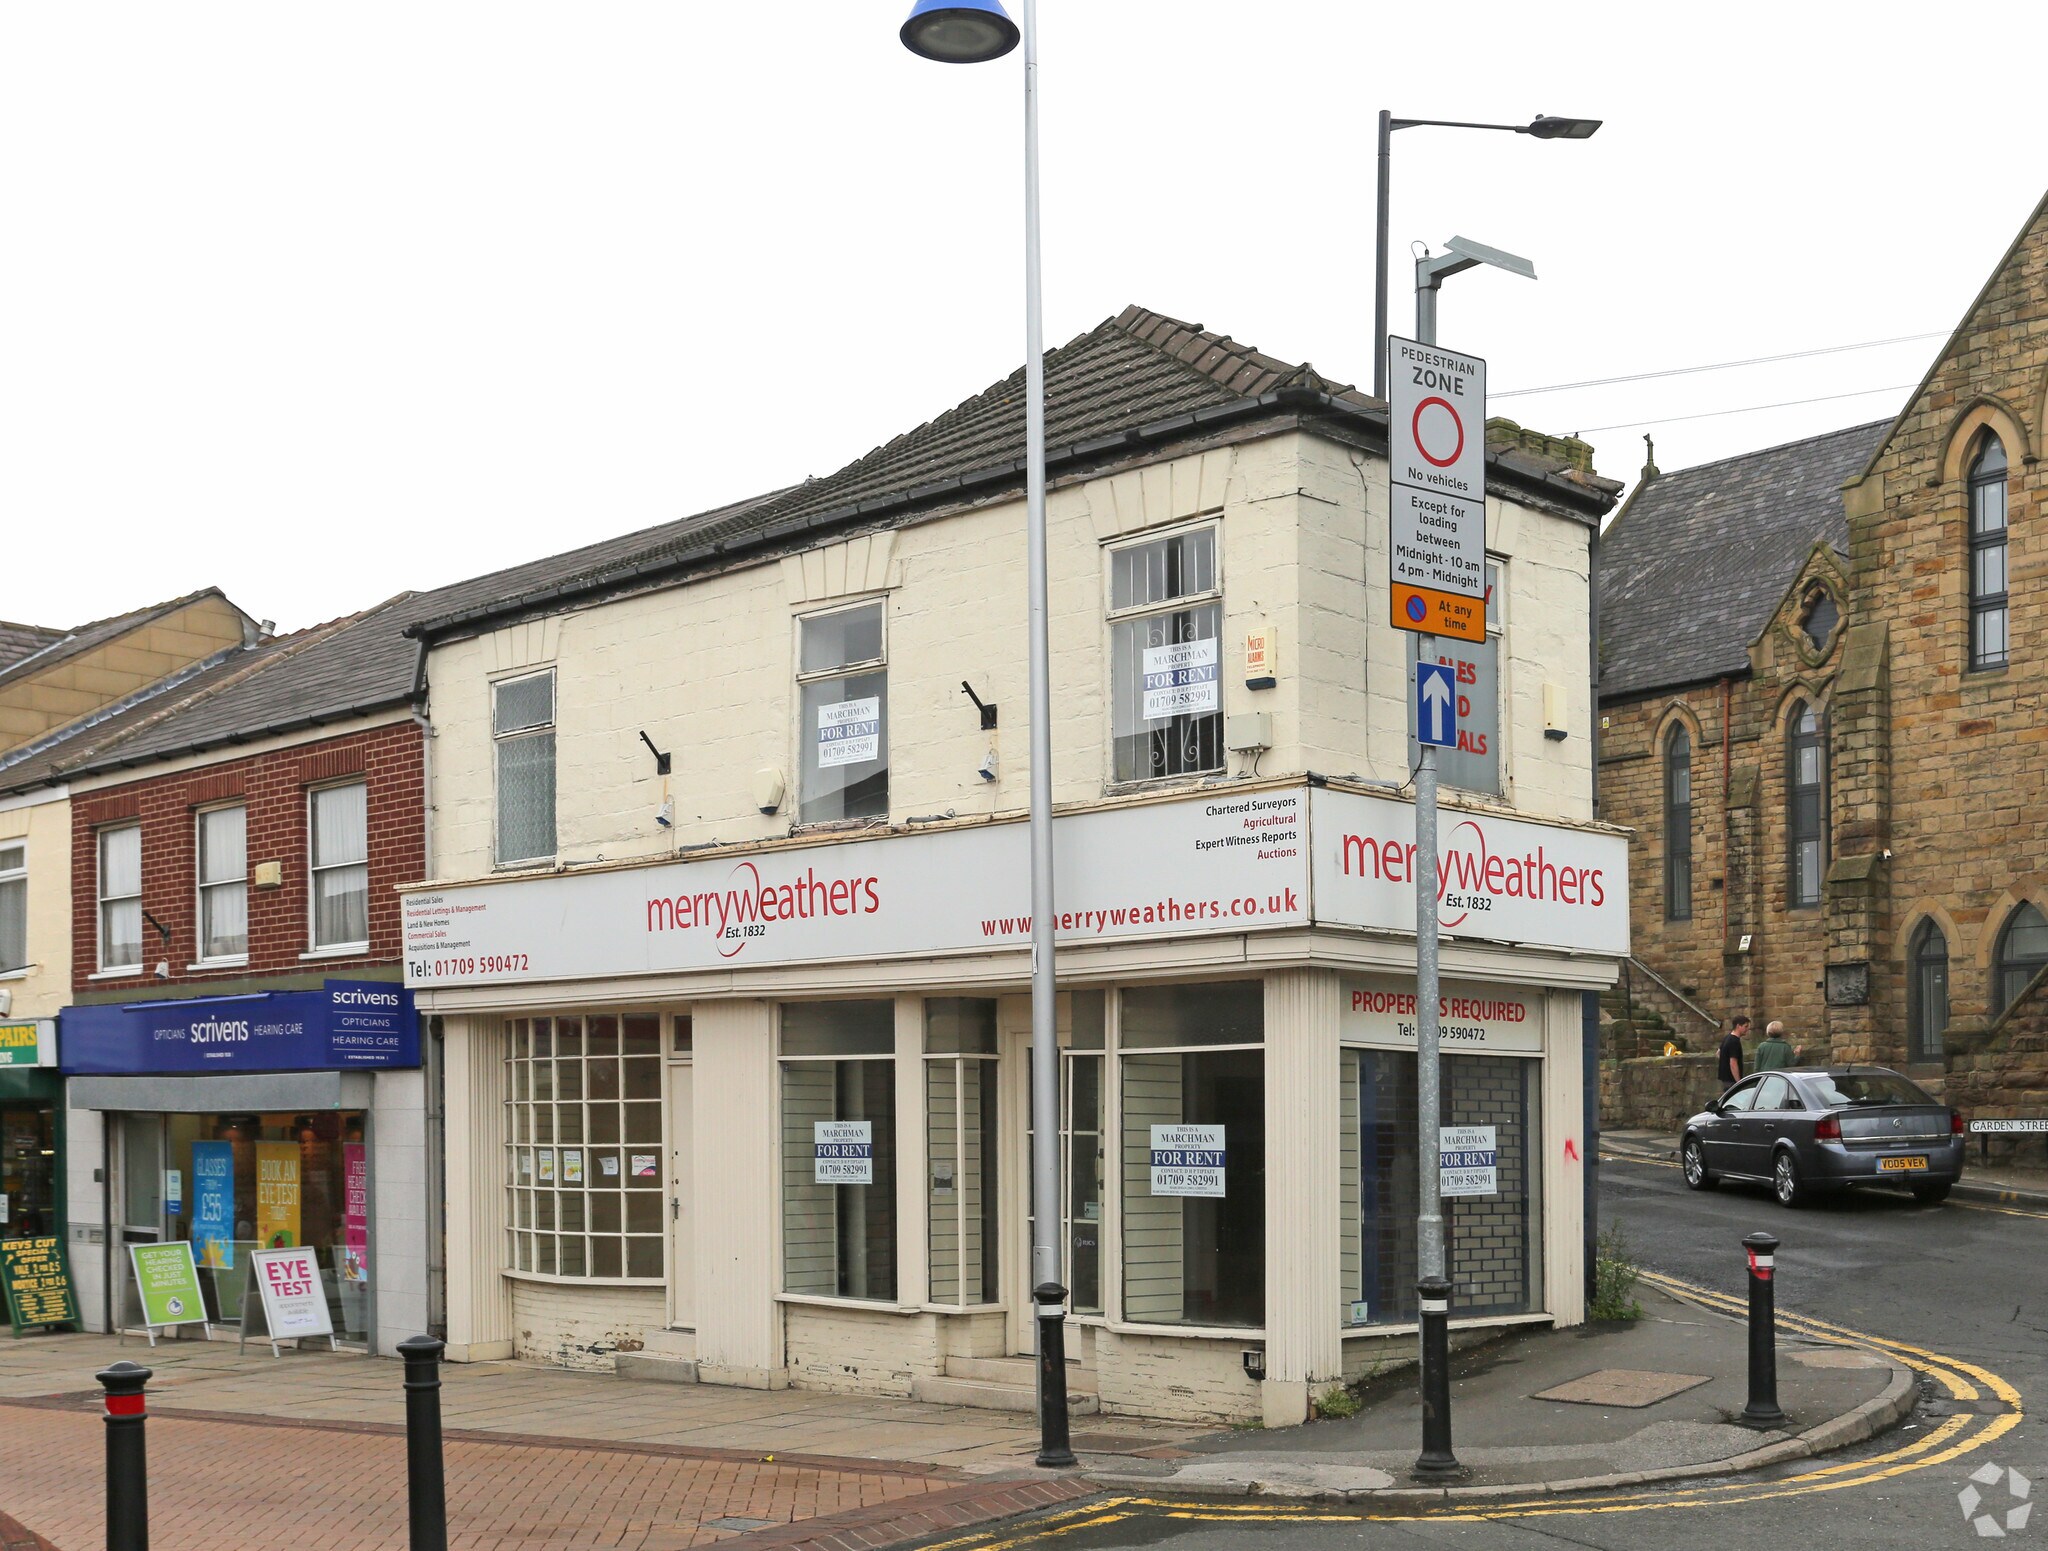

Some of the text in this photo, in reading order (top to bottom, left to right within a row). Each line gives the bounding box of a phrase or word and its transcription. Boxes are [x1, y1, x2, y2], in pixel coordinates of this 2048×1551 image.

[1401, 346, 1474, 376] PEDESTRIAN
[1412, 366, 1464, 396] ZONE
[1408, 467, 1468, 491] No vehicles
[1412, 496, 1466, 518] Except for
[1419, 512, 1458, 532] loading
[1416, 530, 1460, 550] between
[1396, 544, 1443, 565] Midnight
[1451, 556, 1462, 568] 10
[1465, 561, 1480, 572] am
[1398, 562, 1406, 574] 4
[1408, 568, 1424, 578] pm
[1433, 568, 1478, 588] Midnight
[1439, 600, 1472, 618] At any
[1444, 616, 1467, 630] time
[1154, 649, 1208, 666] MARCHMAN
[1146, 666, 1214, 688] FOR RENT
[1150, 695, 1176, 708] 01709
[1179, 690, 1210, 704] 582991
[827, 706, 870, 720] MARCHMAN
[821, 721, 876, 740] FOR RENT
[823, 746, 845, 758] 01709
[848, 742, 872, 754] 582991
[1206, 798, 1296, 816] Chartered Surveyors
[1244, 813, 1296, 830] Agricultural
[1196, 831, 1296, 851] Expert Witness Reports
[1258, 848, 1296, 860] Auctions
[1343, 824, 1604, 906] meryweathers
[406, 897, 430, 906] Residential
[647, 862, 880, 939] merryweathers
[1446, 894, 1492, 911] Est. 1832
[407, 908, 431, 917] Residential
[432, 906, 450, 916] Lettings
[456, 904, 486, 913] Management
[982, 888, 1298, 936] wwwerryweathers.co.uk
[408, 931, 434, 940] Commercial
[726, 925, 766, 938] Est. 1832
[409, 943, 435, 952] Acquisitions
[440, 940, 470, 950] Management
[409, 954, 528, 978] Tel: 01709 590472
[333, 989, 398, 1006] scrivens
[1352, 991, 1526, 1023] PROPERS REQUIRED
[154, 1015, 303, 1043] OPTICIANS scrivens HEARING CARE
[342, 1018, 390, 1026] OPTICIANS
[1398, 1022, 1415, 1037] Tel:
[1450, 1026, 1485, 1040] 590472
[332, 1036, 399, 1046] HEARING CARE
[1973, 1121, 2013, 1130] GARDEN
[1161, 1134, 1214, 1142] MARCHMAN
[1444, 1135, 1487, 1144] MARCHMAN
[817, 1145, 869, 1156] FOR RENT
[1154, 1151, 1222, 1166] FOR RENT
[1440, 1152, 1494, 1166] FOR RENT
[197, 1158, 226, 1176] GLASSES
[262, 1160, 296, 1181] BOOK AN
[820, 1165, 866, 1174] 01709 582991
[1908, 1158, 1924, 1168] VEK
[1157, 1174, 1218, 1186] 01709 582991
[1442, 1174, 1491, 1186] 01709 582991
[260, 1183, 298, 1204] EYE TEST
[202, 1193, 221, 1220] £55
[2, 1238, 56, 1251] KEYS CUT
[16, 1248, 50, 1257] SPECIAL
[146, 1264, 184, 1273] CHECKED
[266, 1260, 311, 1280] EYE
[271, 1280, 312, 1296] TEST
